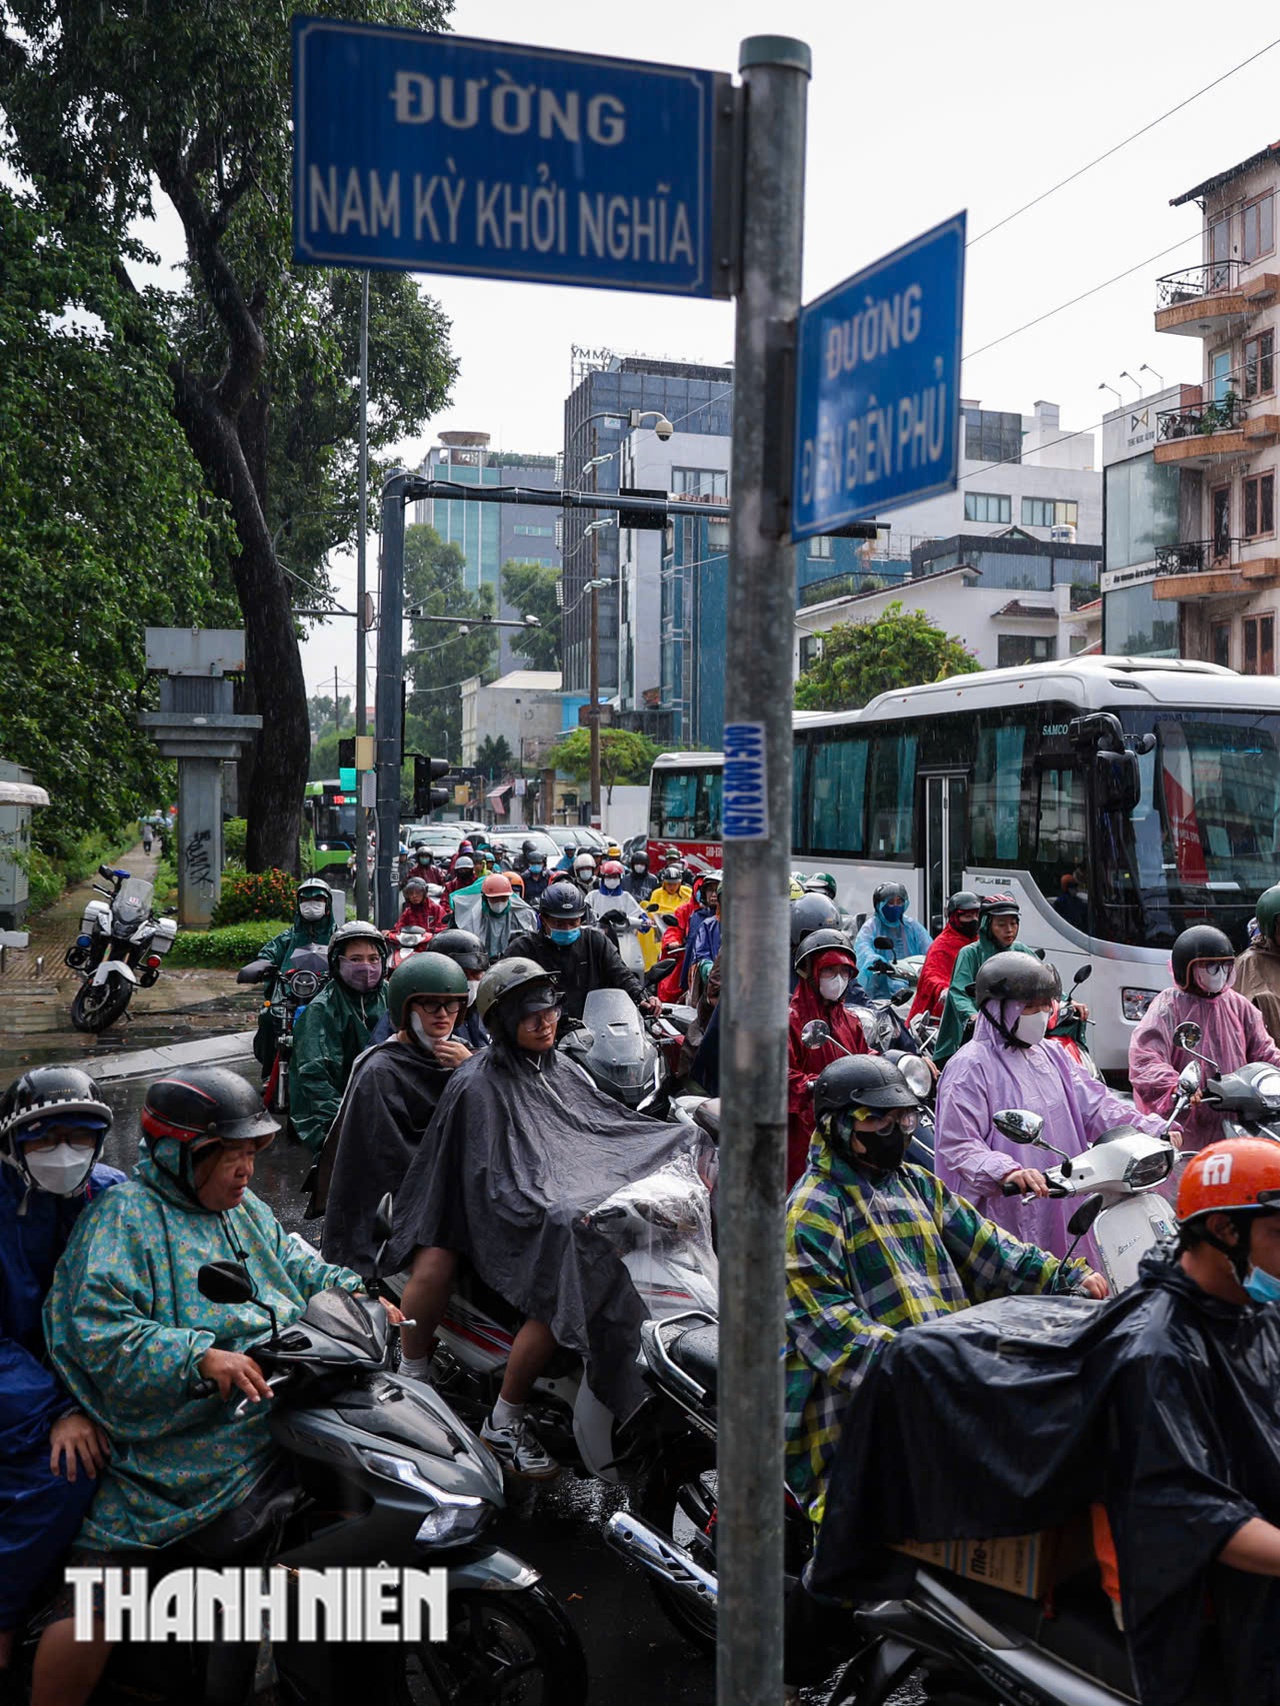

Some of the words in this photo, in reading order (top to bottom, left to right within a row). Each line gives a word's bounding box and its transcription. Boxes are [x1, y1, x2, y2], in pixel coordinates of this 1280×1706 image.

[390, 69, 626, 146] ĐƯỜNG
[308, 164, 401, 239] NAM
[413, 156, 466, 244] KỲ
[475, 162, 567, 255] KHỞI
[579, 182, 696, 267] NGHĨA
[826, 283, 923, 380] ĐƯỜNG
[847, 394, 894, 490] BIÊN
[897, 355, 947, 472] PHỦ
[1042, 724, 1068, 736] SAMCO
